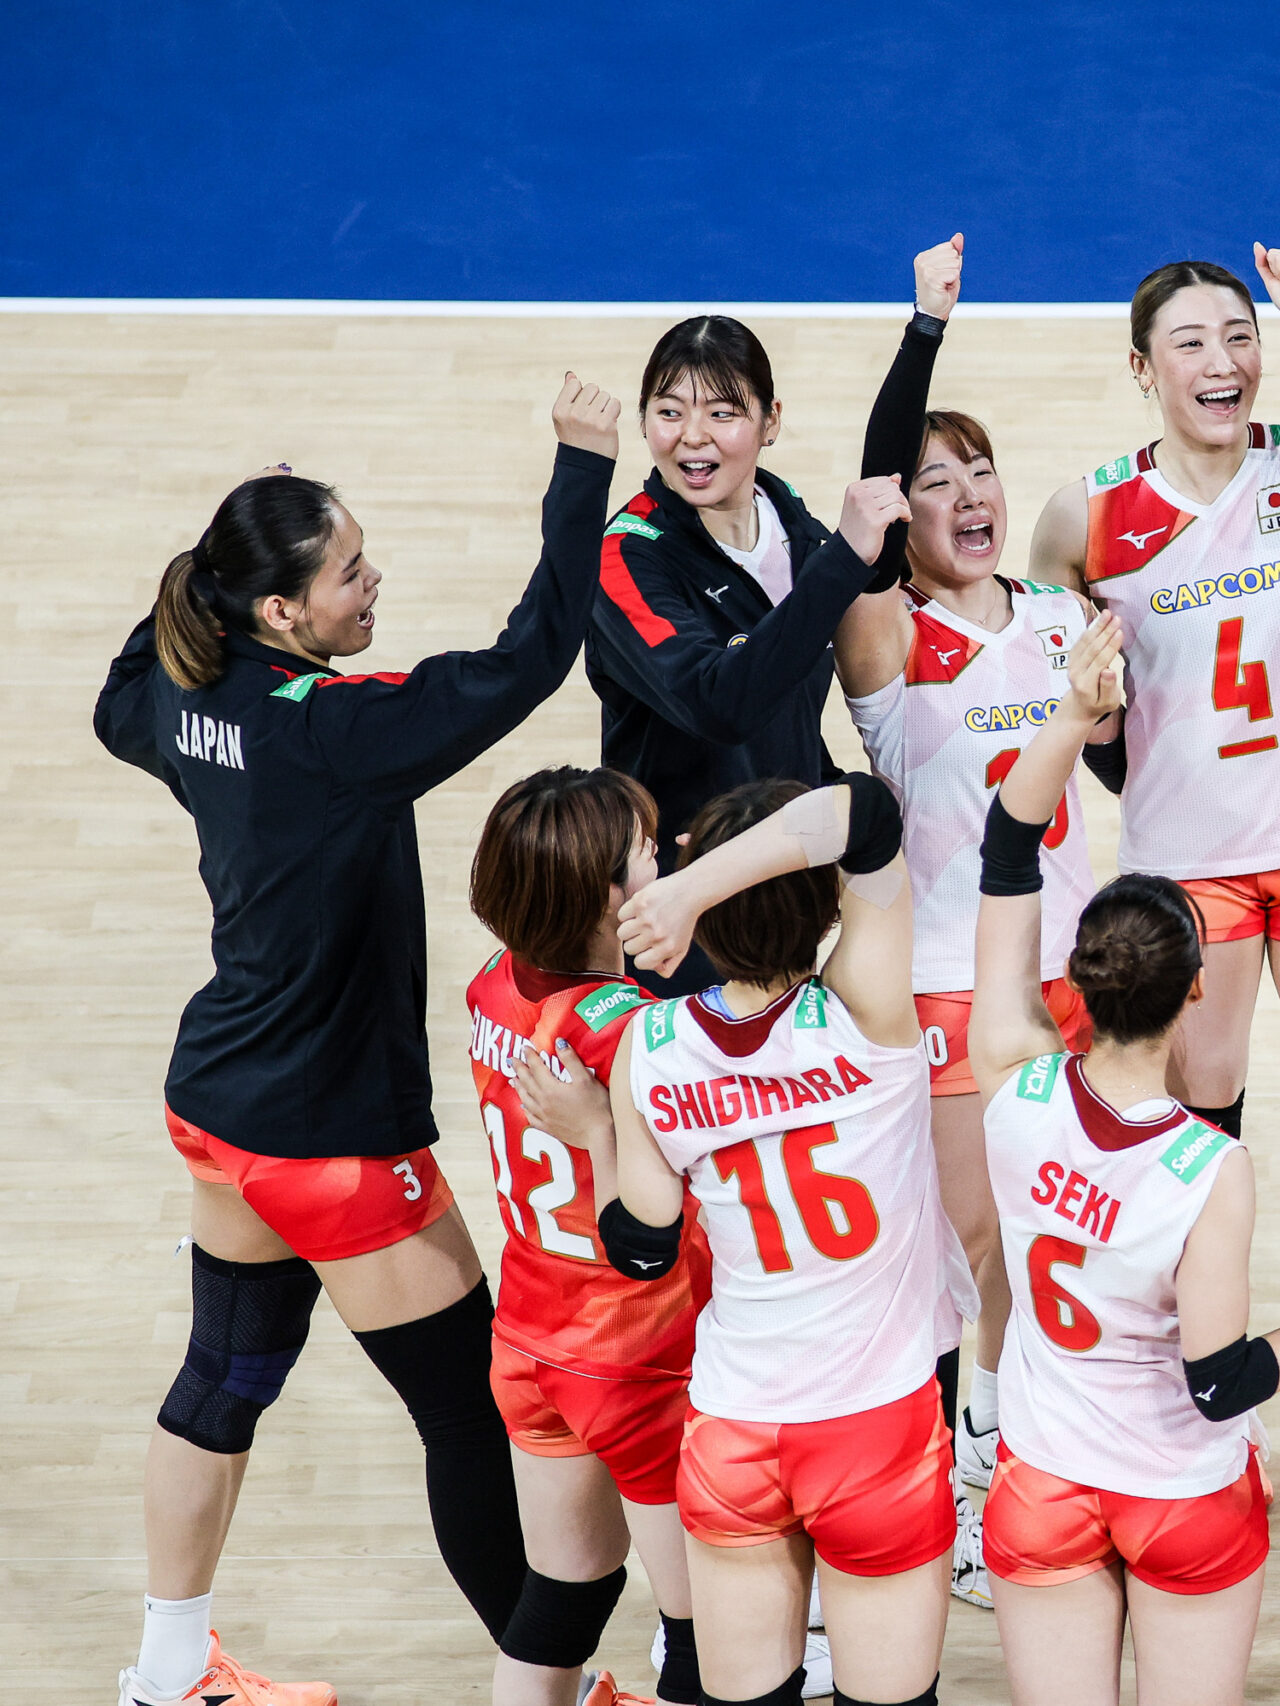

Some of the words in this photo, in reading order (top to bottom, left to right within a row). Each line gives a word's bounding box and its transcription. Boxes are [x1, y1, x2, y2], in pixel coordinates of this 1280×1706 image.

[1211, 617, 1273, 722] 4
[175, 709, 245, 771] JAPAN
[650, 1055, 873, 1133] SHIGIHARA
[392, 1159, 422, 1202] 3
[481, 1101, 596, 1261] 12
[712, 1123, 880, 1274] 16
[1030, 1161, 1121, 1245] SEKI
[1026, 1233, 1102, 1352] 6
